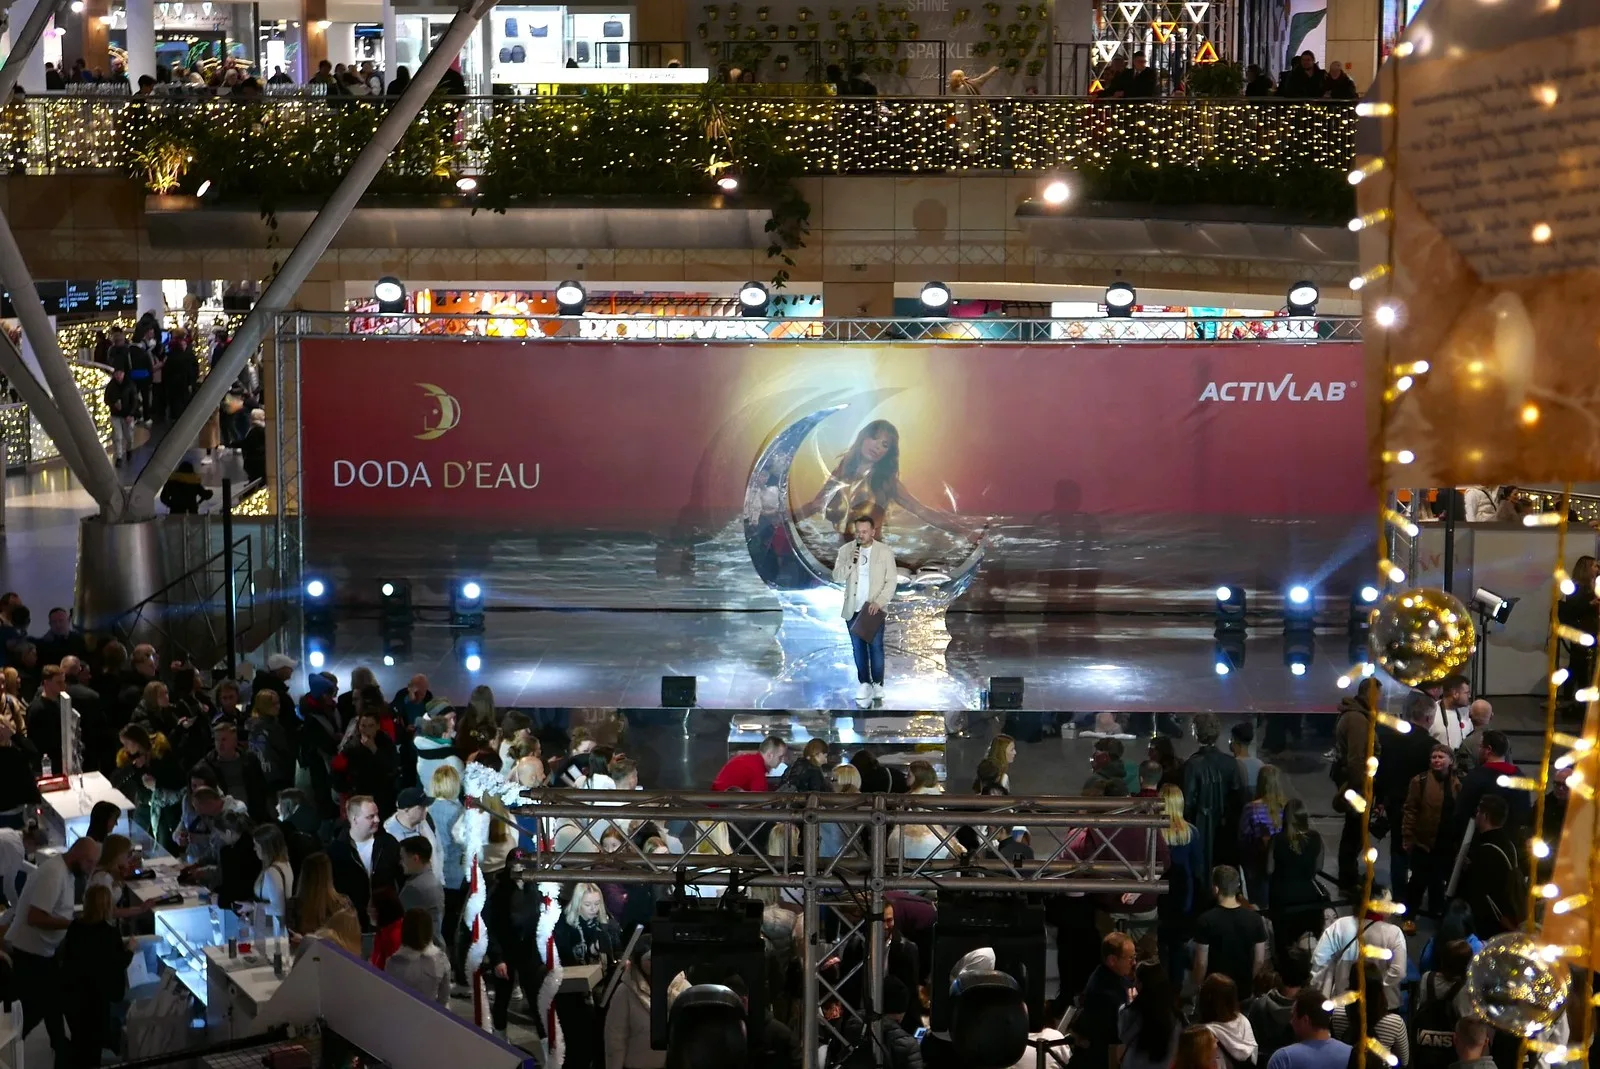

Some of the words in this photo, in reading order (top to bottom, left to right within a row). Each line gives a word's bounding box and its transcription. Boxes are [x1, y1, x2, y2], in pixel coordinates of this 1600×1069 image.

[907, 0, 949, 12] SHINE
[907, 42, 973, 59] SPARKLE
[333, 460, 432, 488] DODA
[444, 461, 541, 490] D’EAU
[1417, 1028, 1454, 1047] VANS
